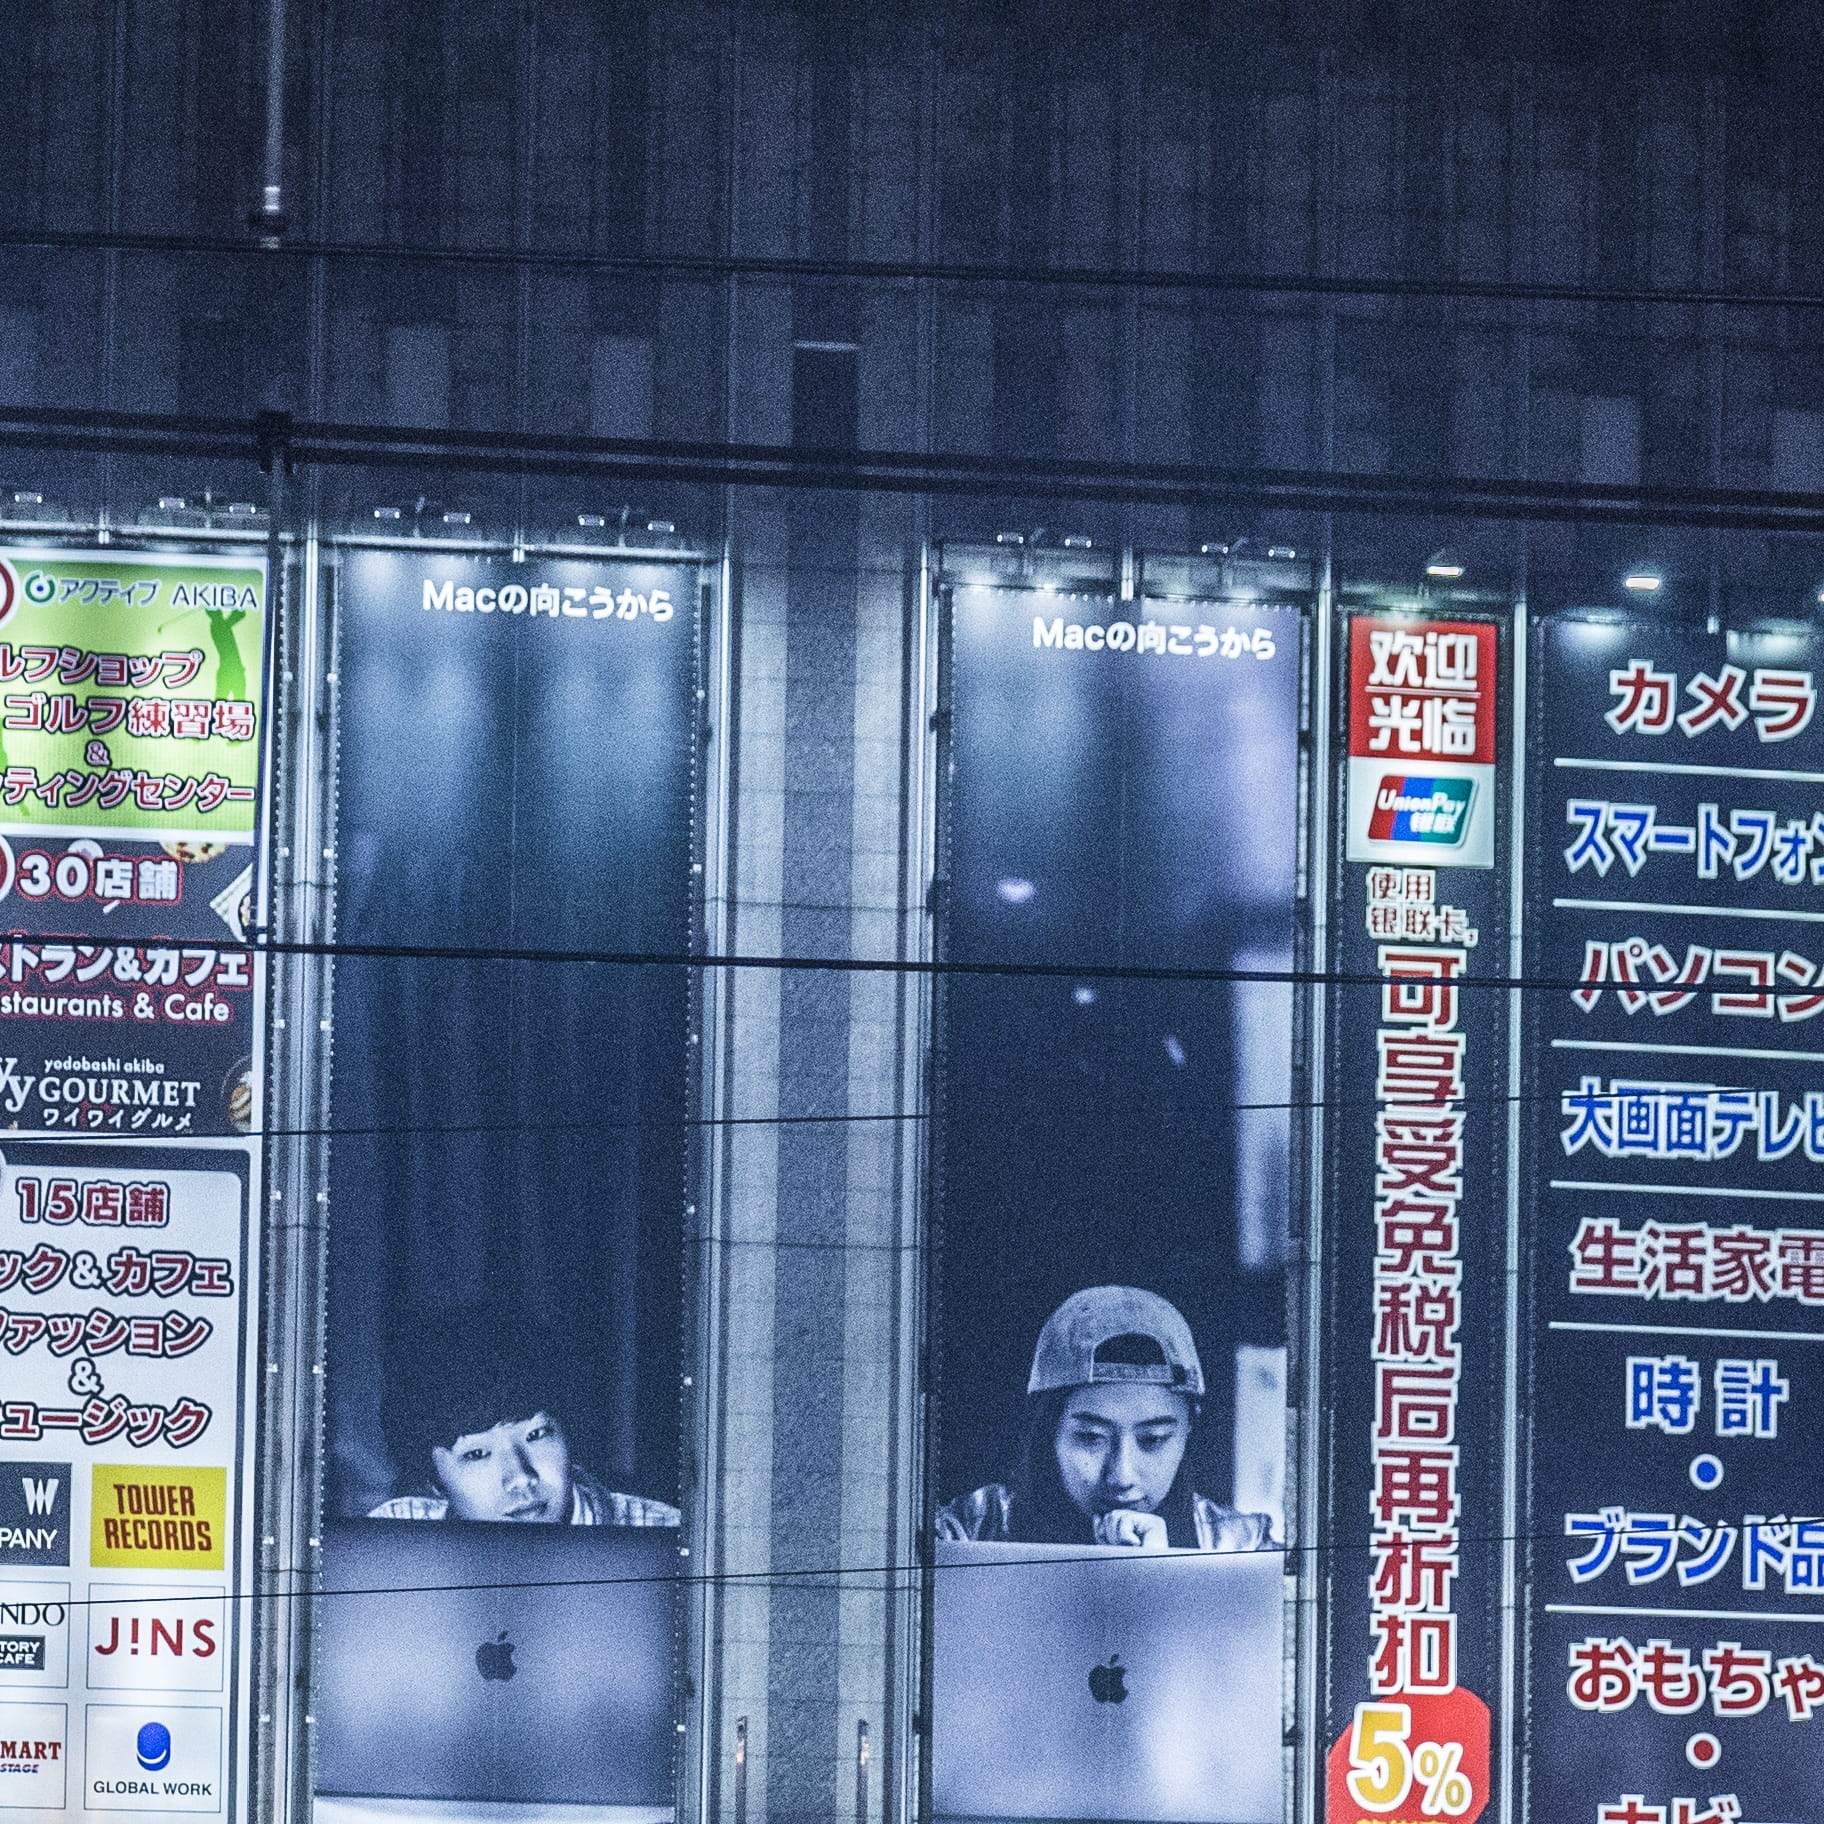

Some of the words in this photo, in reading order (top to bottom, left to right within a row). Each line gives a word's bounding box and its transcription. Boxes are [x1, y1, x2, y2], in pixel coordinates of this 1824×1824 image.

[58, 578, 162, 606] アクティブ
[172, 583, 258, 609] AKIBA
[422, 580, 674, 622] Macの向こうから
[1033, 617, 1276, 660] Macの向こうから
[1367, 630, 1479, 691] 欢迎
[3, 692, 255, 740] ゴルフ練習場
[1605, 660, 1816, 742] カメラ
[1367, 695, 1477, 756] 光临
[1378, 788, 1466, 817] UnionPay
[17, 851, 180, 903] 30店舗
[1366, 867, 1436, 904] 使用
[133, 992, 156, 1020] &
[164, 993, 231, 1022] Cafe
[44, 1057, 121, 1073] yodobashi
[124, 1058, 165, 1075] akiba
[39, 1077, 201, 1107] GOURMET
[42, 1107, 193, 1131] ワイワイグルメ
[16, 1178, 171, 1227] 15店舗
[1625, 1356, 1789, 1438] 時計
[113, 1484, 196, 1516] TOWER
[103, 1518, 212, 1551] RECORDS
[0, 1763, 39, 1774] STAGE
[1347, 1702, 1473, 1816] 5%
[93, 1780, 160, 1796] GLOBAL
[163, 1782, 212, 1796] WORK
